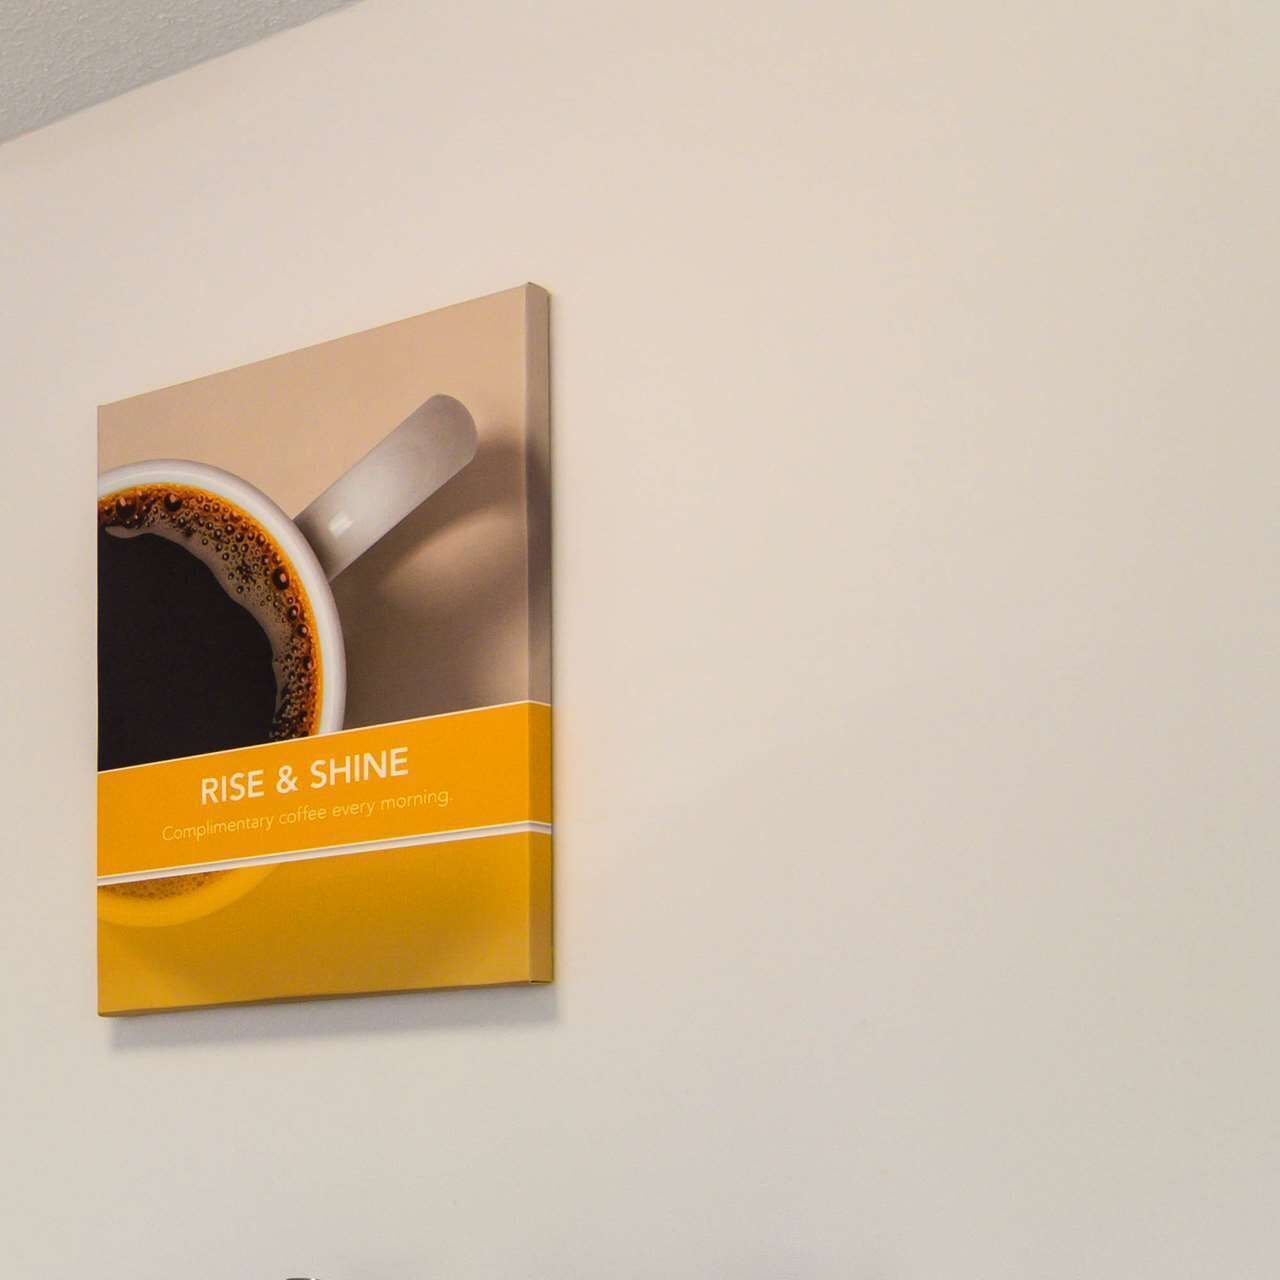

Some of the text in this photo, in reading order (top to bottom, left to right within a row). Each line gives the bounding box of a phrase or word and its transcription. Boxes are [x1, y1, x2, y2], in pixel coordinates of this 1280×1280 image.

[201, 747, 409, 805] RISE & SHINE
[161, 815, 274, 841] Complimentary
[279, 803, 327, 824] coffee
[331, 799, 376, 820] every
